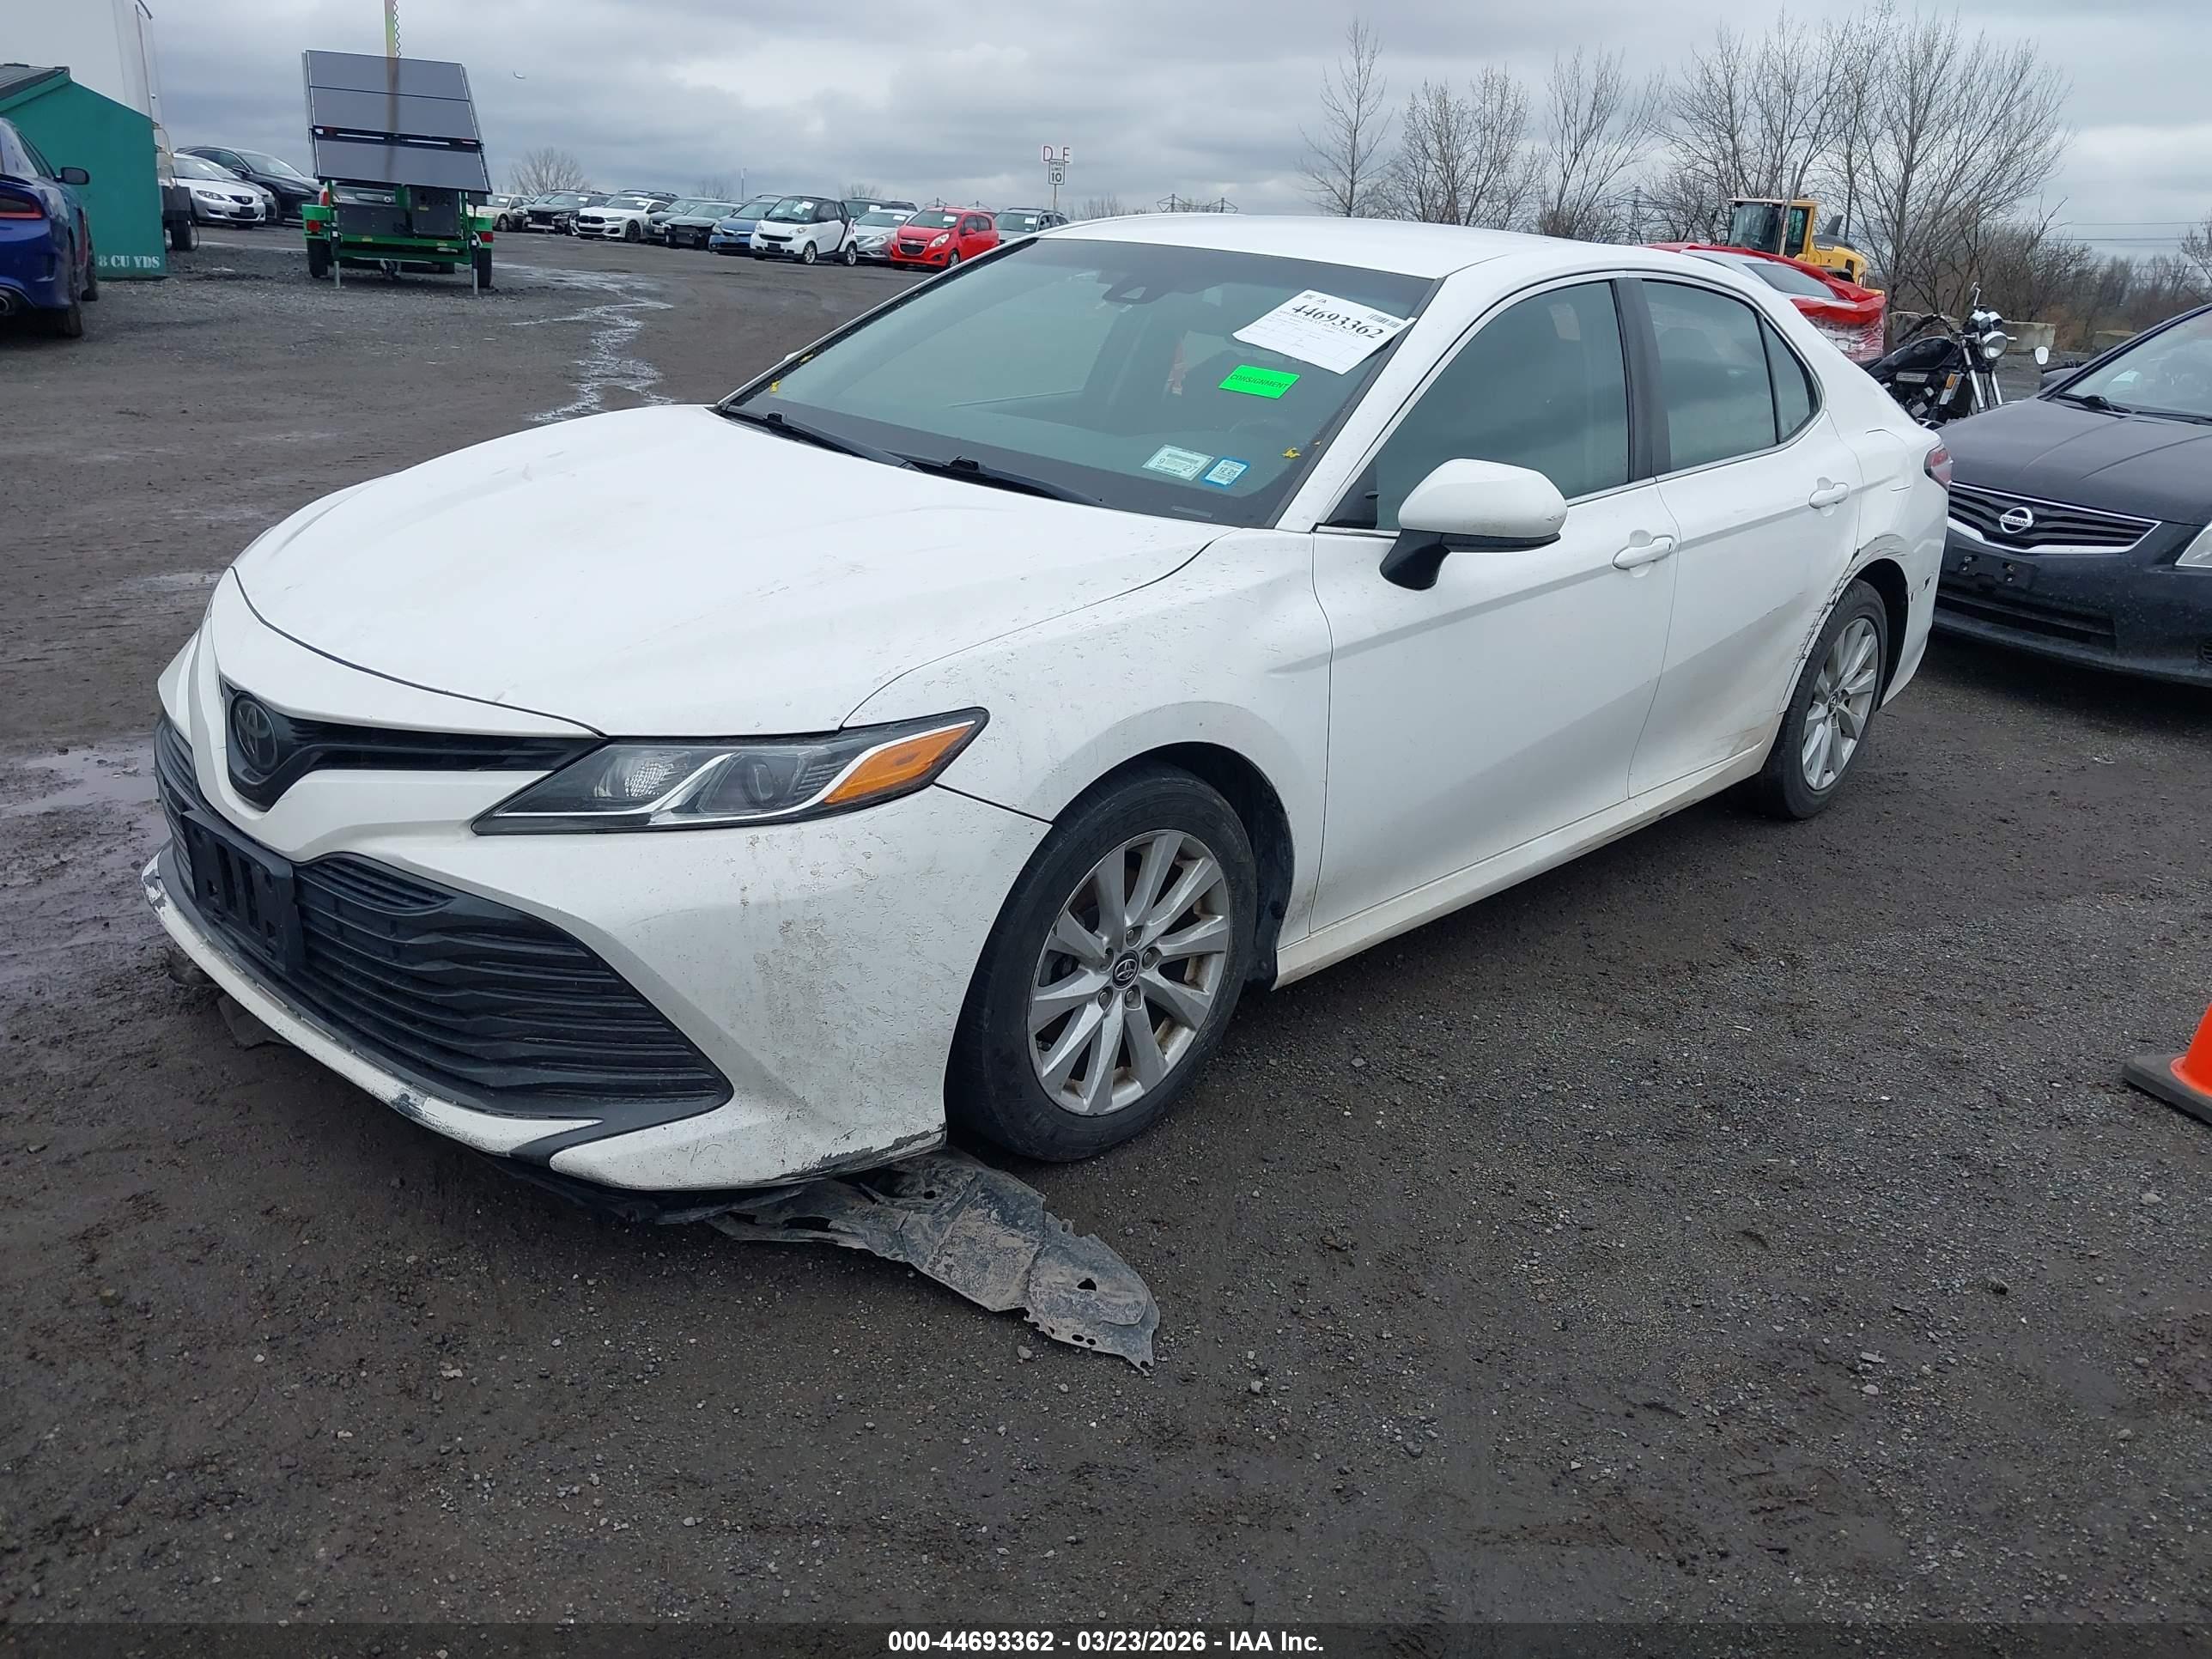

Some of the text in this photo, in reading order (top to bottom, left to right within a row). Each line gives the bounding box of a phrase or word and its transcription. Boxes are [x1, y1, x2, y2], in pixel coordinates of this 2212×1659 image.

[1043, 146, 1054, 161] D
[1051, 172, 1062, 183] 10
[98, 255, 160, 269] 8 CU YDS
[1291, 304, 1384, 338] 44693362
[1230, 374, 1290, 389] CONSIGNMENT
[1182, 465, 1199, 473] 27
[2002, 516, 2028, 526] NISSAN
